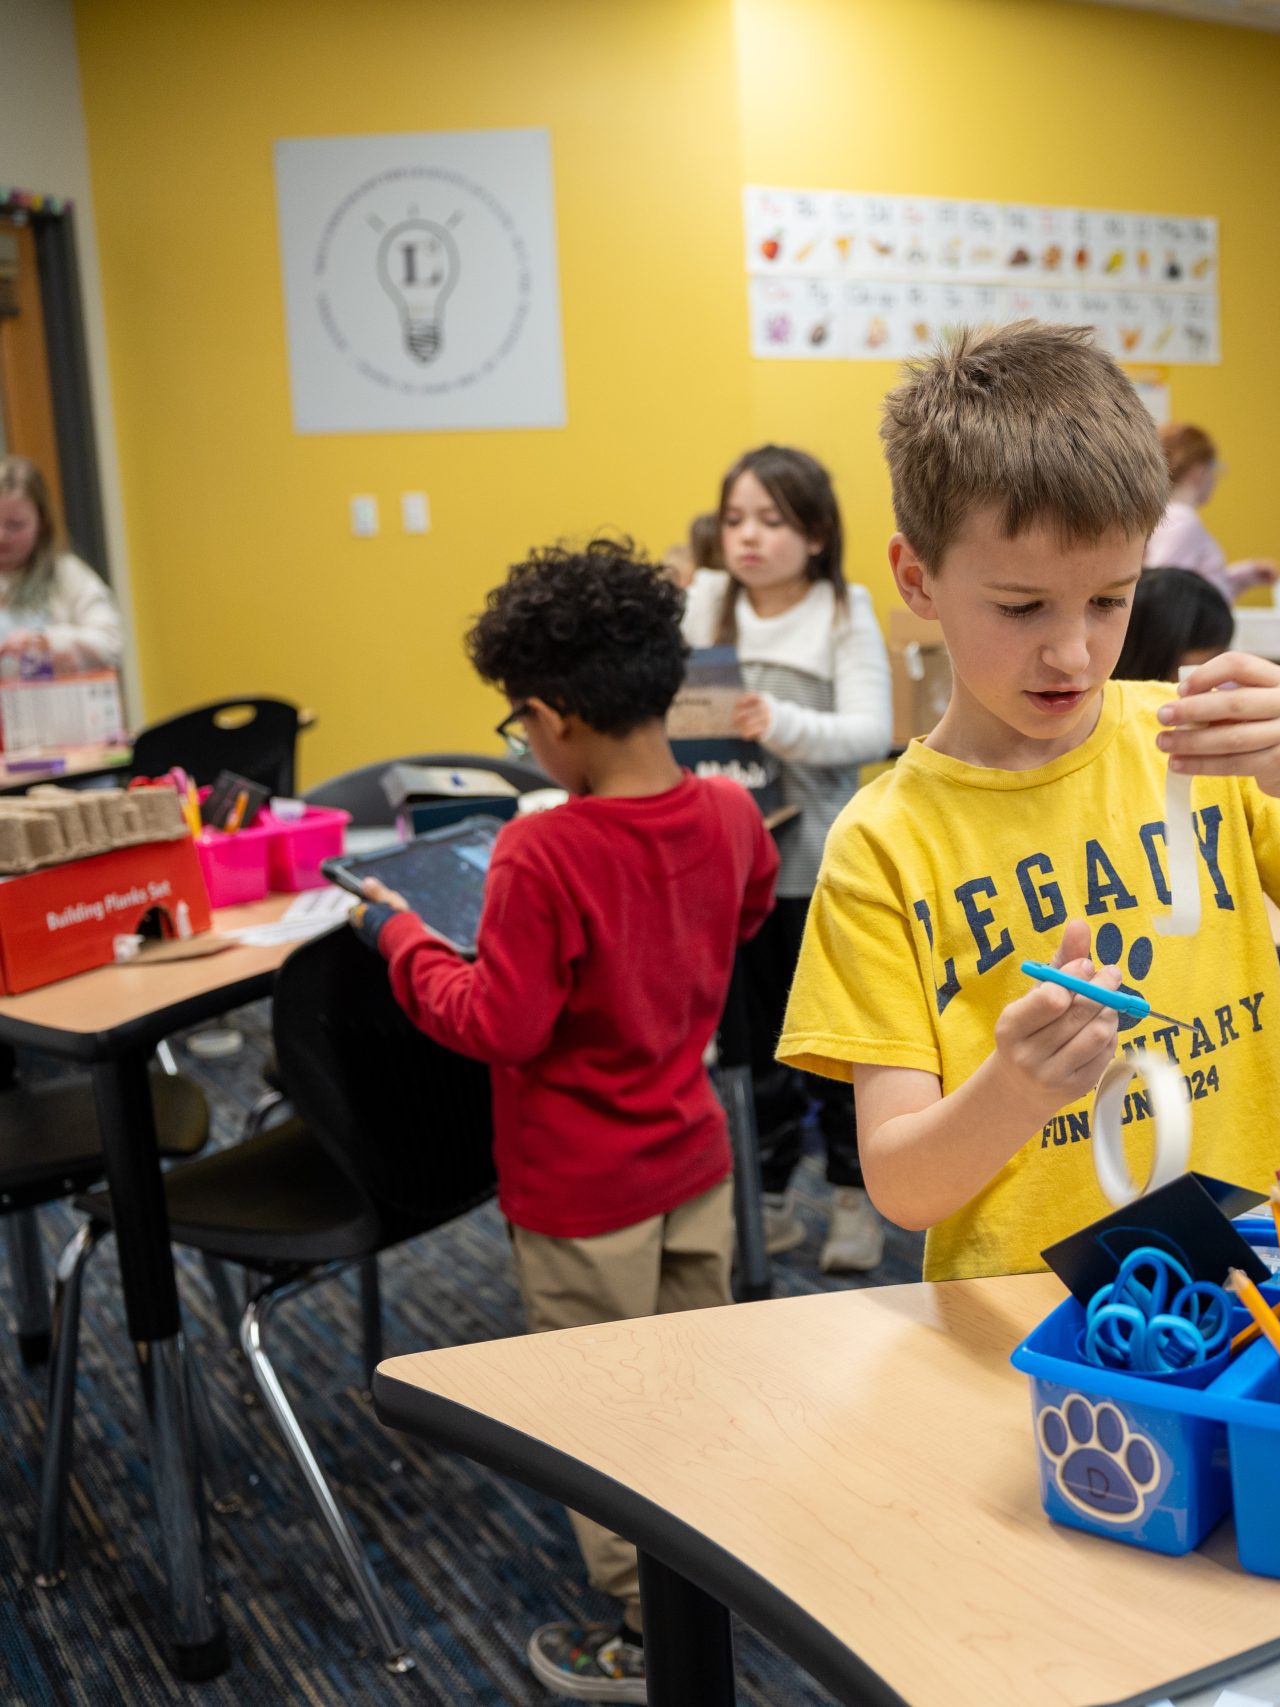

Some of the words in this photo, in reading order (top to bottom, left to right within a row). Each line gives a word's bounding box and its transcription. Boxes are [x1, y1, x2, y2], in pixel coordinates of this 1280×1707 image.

[46, 901, 104, 931] Building
[104, 886, 148, 913] Planks
[147, 880, 172, 900] Set
[914, 804, 1235, 1017] LEGACY
[1041, 1111, 1091, 1149] FUN
